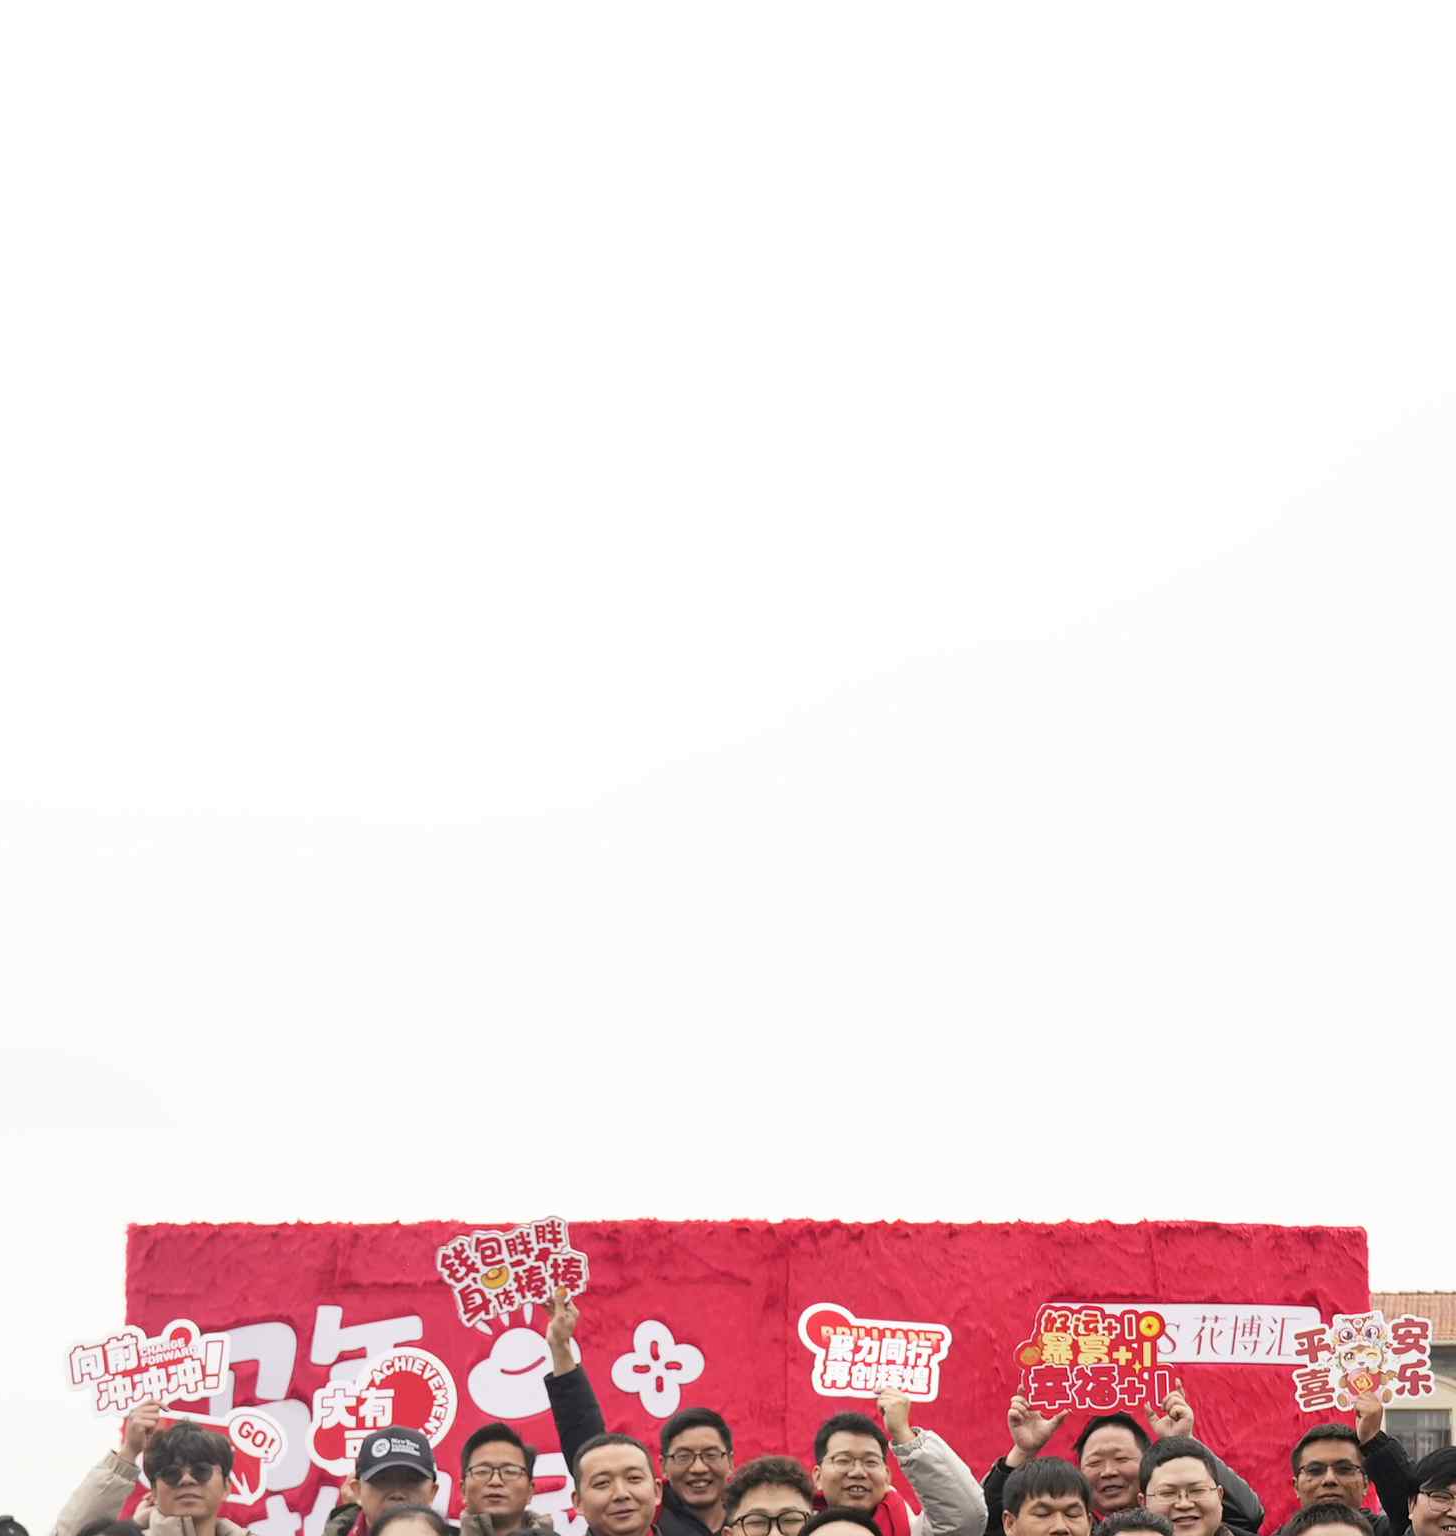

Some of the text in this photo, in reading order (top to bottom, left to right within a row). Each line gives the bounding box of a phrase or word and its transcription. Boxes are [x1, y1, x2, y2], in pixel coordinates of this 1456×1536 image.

[441, 1220, 563, 1283] 钱包胖胖
[827, 1335, 933, 1366] 聚力同行
[1193, 1315, 1301, 1356] 花博汇
[71, 1334, 139, 1383] 向前
[371, 1355, 449, 1439] ACHIEVEMEN
[238, 1420, 276, 1454] GO!
